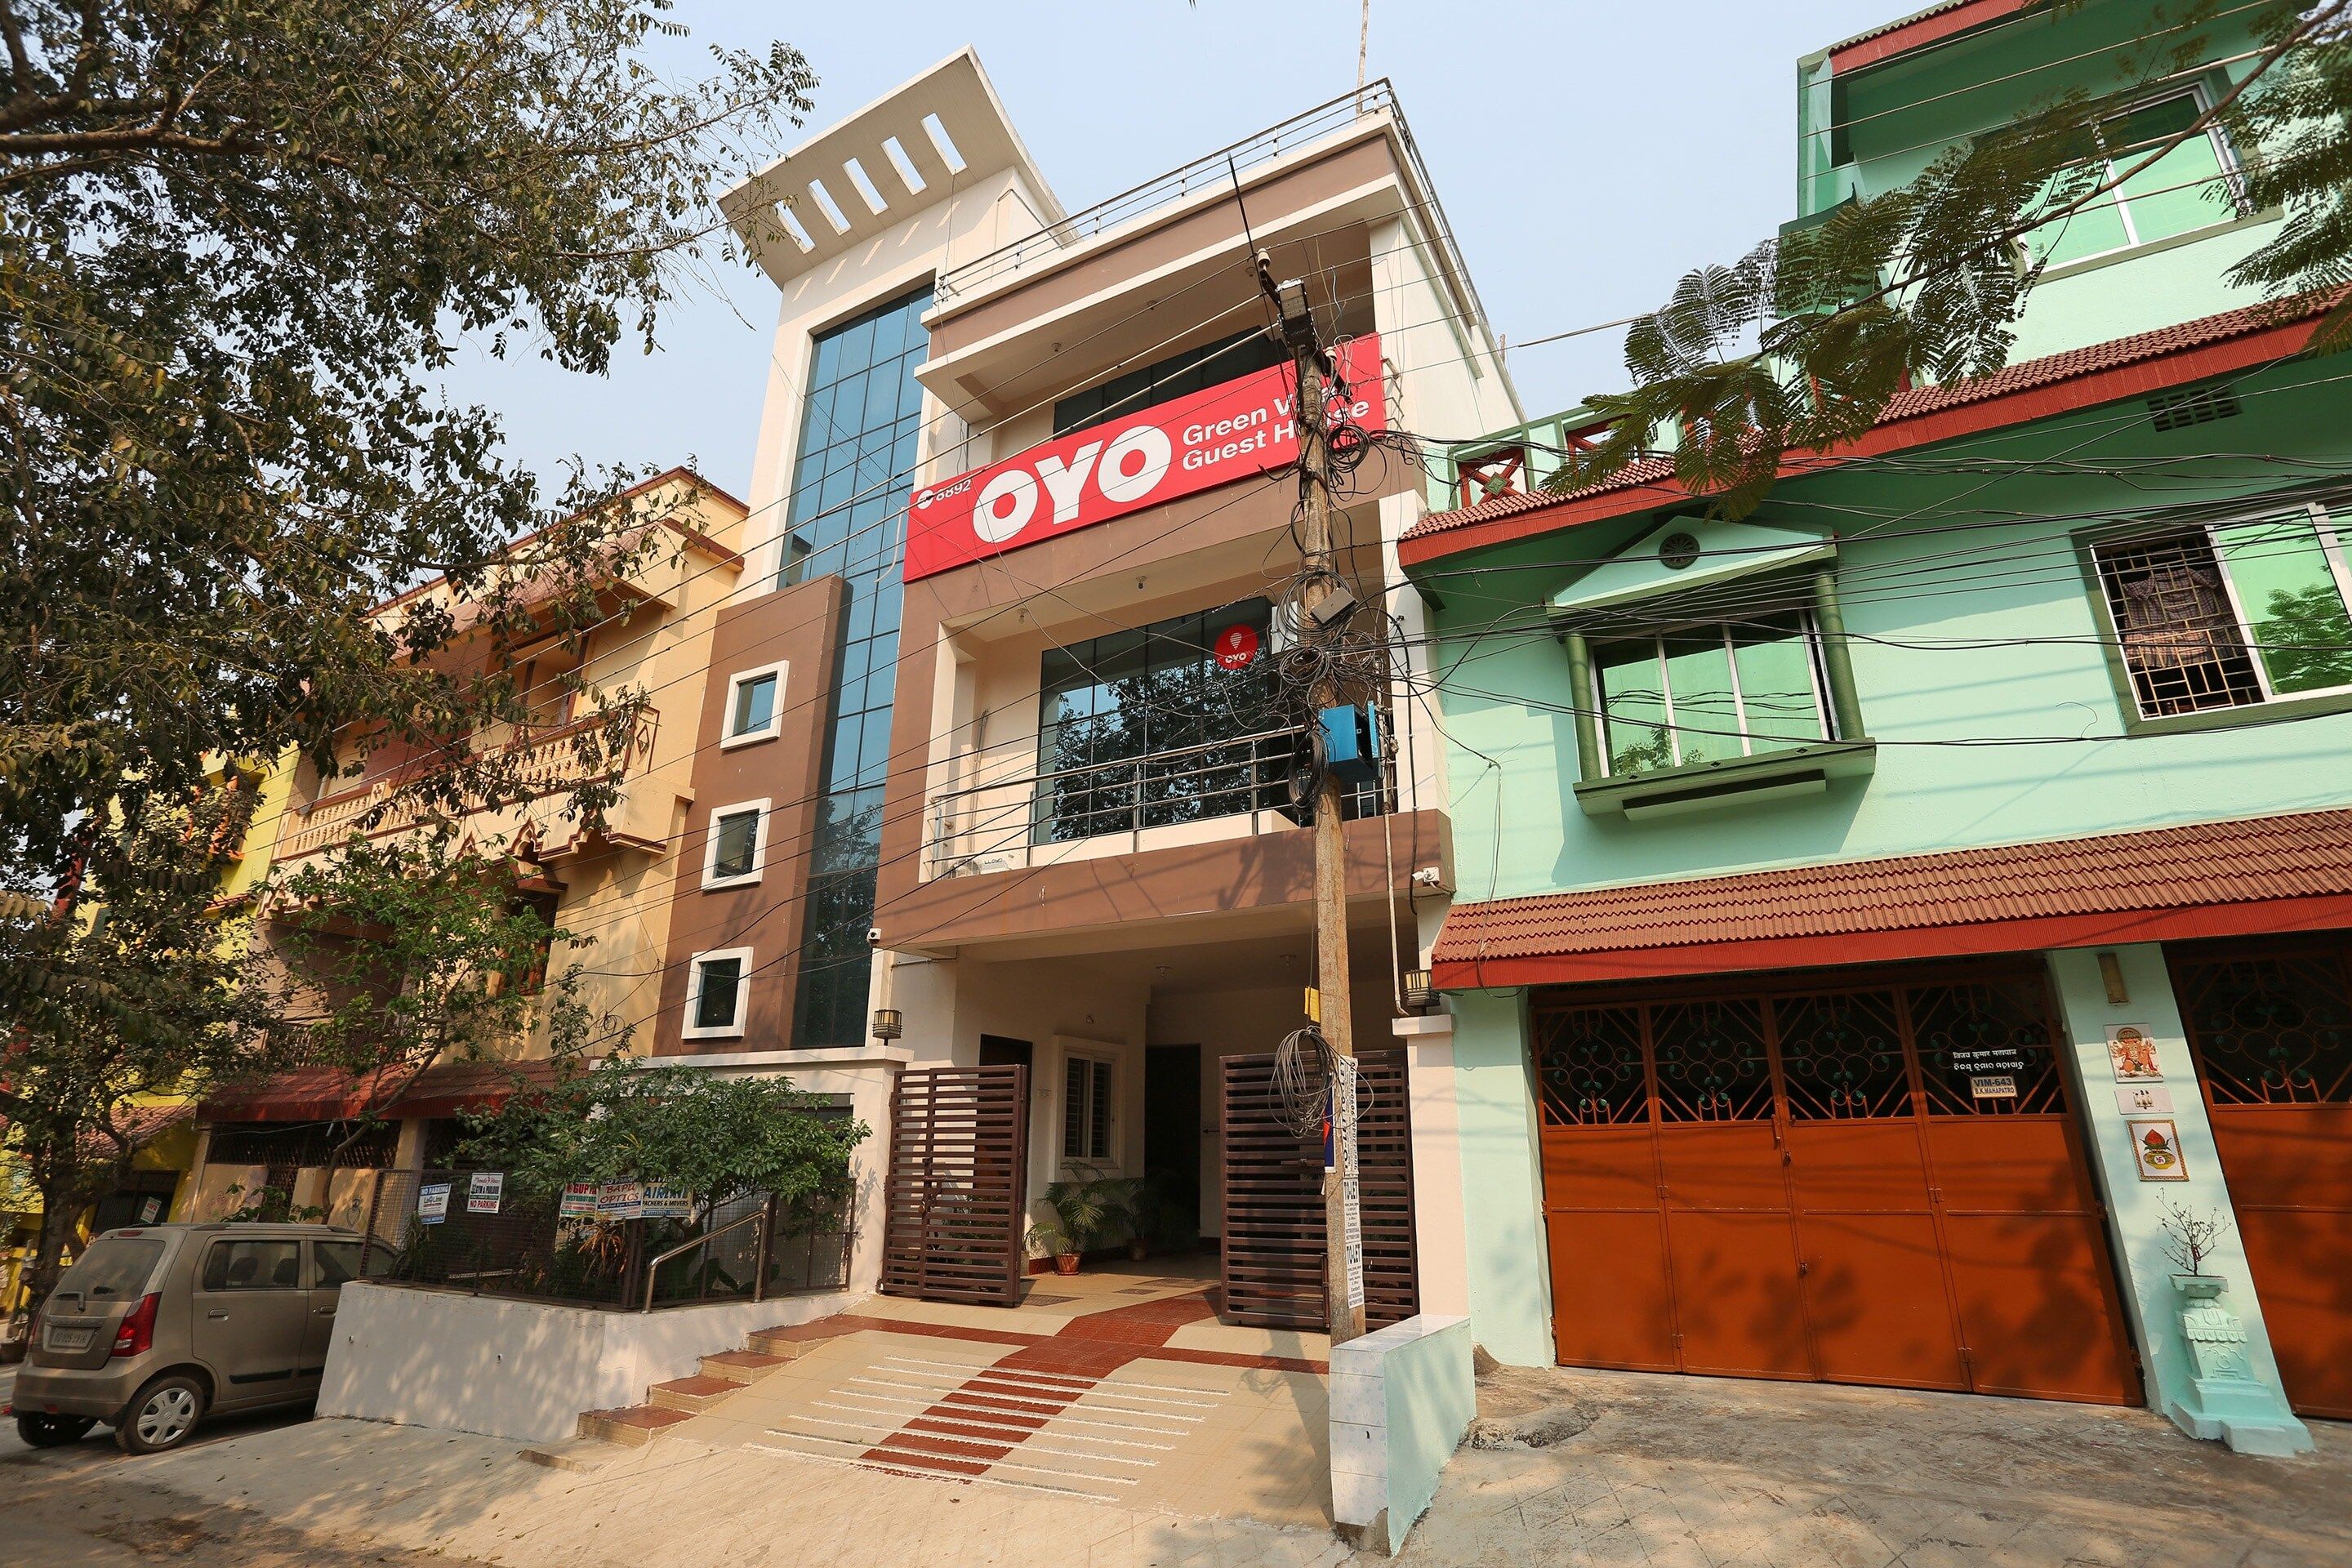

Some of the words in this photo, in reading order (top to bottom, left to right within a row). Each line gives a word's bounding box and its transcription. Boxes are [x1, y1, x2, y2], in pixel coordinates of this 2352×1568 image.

[1183, 408, 1267, 446] Green
[1183, 430, 1267, 470] Guest
[1274, 401, 1370, 444] Hse
[972, 425, 1172, 543] OYO
[1225, 652, 1247, 664] OYO
[1973, 1078, 2012, 1087] VIM-643
[429, 1185, 448, 1194] PARKING
[606, 1181, 635, 1193] BAPU
[600, 1192, 639, 1204] OPTICS
[478, 1200, 497, 1209] PARKING
